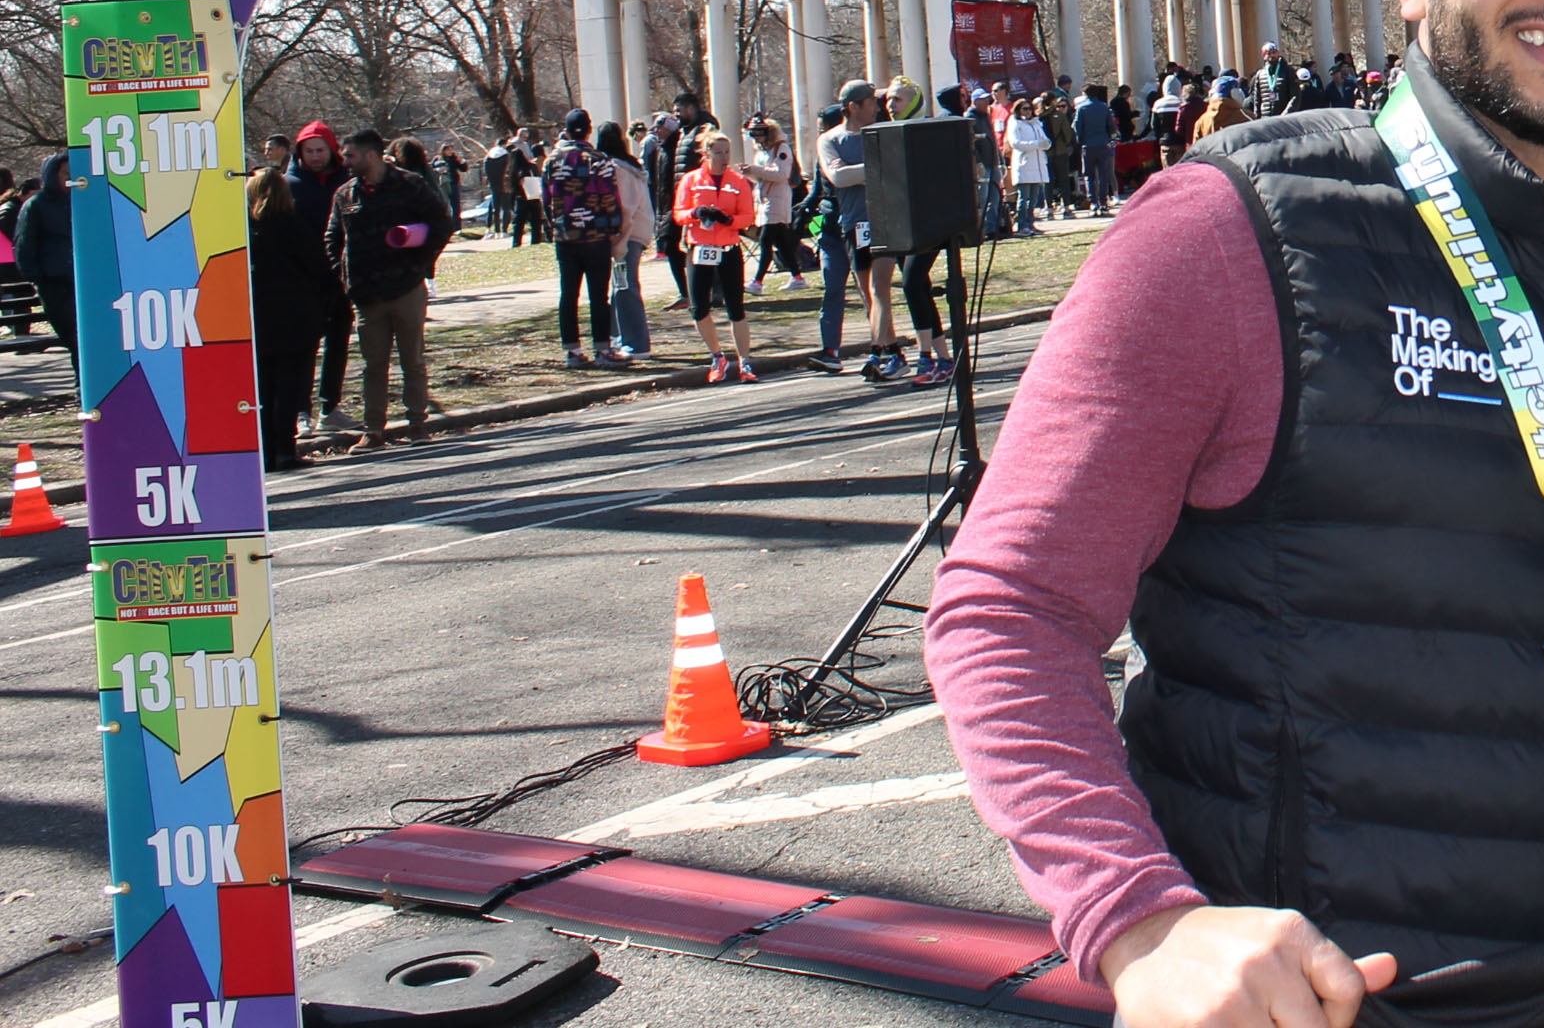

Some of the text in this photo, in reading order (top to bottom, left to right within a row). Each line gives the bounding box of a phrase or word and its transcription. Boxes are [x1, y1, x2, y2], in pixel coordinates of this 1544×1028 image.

[82, 32, 209, 79] CityTri
[90, 83, 107, 92] NOT
[118, 82, 140, 91] RACE
[141, 80, 158, 89] BUT
[159, 80, 166, 88] A
[167, 79, 183, 88] LIFE
[184, 77, 208, 87] TIME!
[81, 114, 220, 177] 13.1m
[112, 288, 204, 352] 10K
[1387, 304, 1452, 342] The
[1391, 333, 1498, 383] Making
[1393, 364, 1434, 397] Of
[134, 464, 202, 527] 5K
[112, 553, 239, 604] CityTri
[120, 609, 138, 618] NOT
[148, 607, 170, 616] RACE
[171, 606, 188, 615] BUT
[189, 605, 196, 614] A
[196, 604, 212, 613] LIFE
[213, 603, 237, 612] TIME!
[111, 649, 260, 714] 13.1m
[146, 823, 245, 887] 10K
